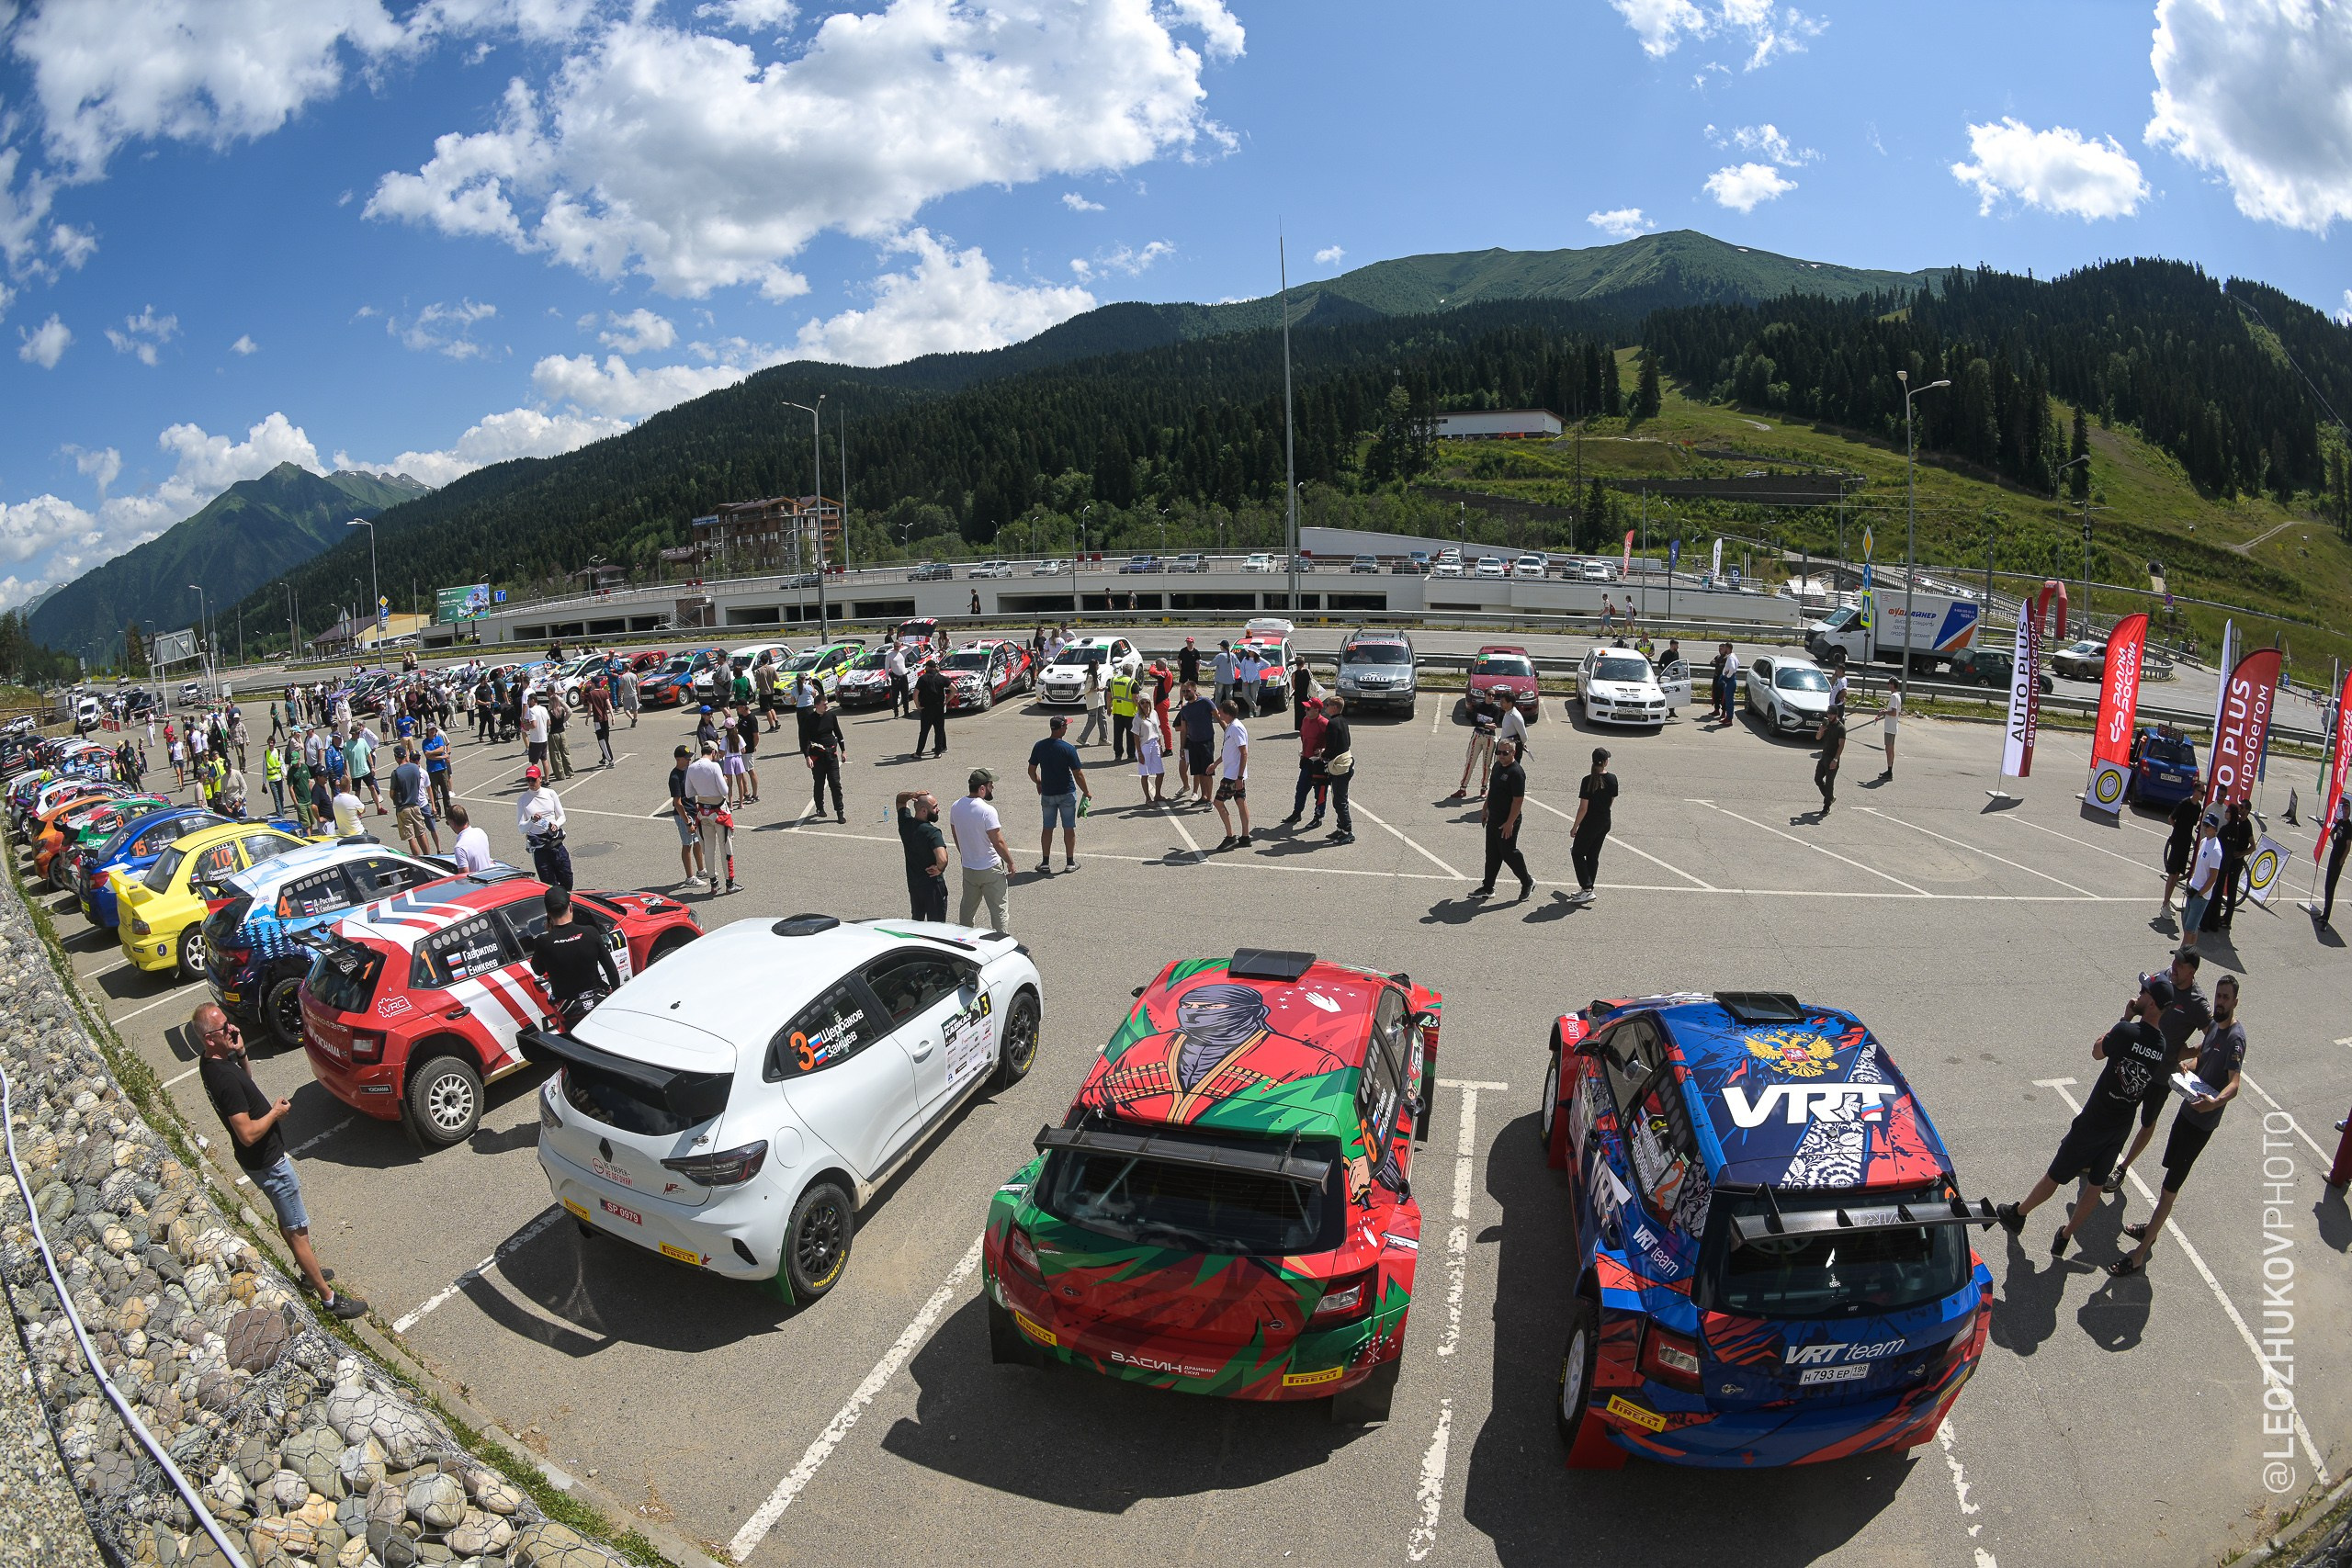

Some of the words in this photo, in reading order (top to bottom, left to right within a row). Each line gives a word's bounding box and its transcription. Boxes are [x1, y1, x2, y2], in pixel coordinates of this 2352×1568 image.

[2018, 621, 2029, 676] PLUS
[2030, 621, 2040, 697] пробегом
[2113, 647, 2127, 705] РАЛЛИ
[2121, 641, 2137, 713] РОССИИ
[2011, 683, 2029, 743] AUTO
[2222, 678, 2251, 757] PLUS
[2026, 714, 2037, 748] авто
[2241, 683, 2269, 782] пробегом
[116, 815, 124, 828] 8
[132, 840, 148, 856] 15
[212, 849, 232, 868] 10
[278, 897, 292, 918] 4
[553, 933, 582, 943] ADVAN
[613, 932, 622, 949] 1
[421, 950, 437, 979] 1
[462, 942, 498, 961] Гаврилов
[363, 961, 374, 980] 1
[467, 959, 499, 976] Еникеев
[383, 998, 406, 1013] VRC
[980, 996, 989, 1015] 3
[819, 1009, 865, 1043] Щербаков
[944, 1012, 972, 1037] КАВКАЗ
[790, 1032, 815, 1071] 3
[824, 1030, 858, 1058] Зайцев
[2131, 1042, 2164, 1062] RUSSIA
[1721, 1082, 1897, 1128] VRT
[1361, 1118, 1377, 1163] 6
[1640, 1116, 1661, 1169] Васильев
[1655, 1160, 1685, 1210] 2
[607, 1202, 618, 1213] SP
[619, 1206, 639, 1223] 0979
[662, 1245, 695, 1263] PIRELLI
[1633, 1224, 1659, 1251] VRT
[1650, 1247, 1679, 1277] team
[813, 1249, 846, 1287] SCORPION
[1018, 1316, 1052, 1342] PIRELLI
[1111, 1350, 1182, 1372] ВАСИН
[1785, 1343, 1849, 1364] VRT
[1844, 1338, 1905, 1361] team
[1287, 1370, 1339, 1385] PIRELLI
[1853, 1365, 1867, 1373] 198
[1612, 1398, 1661, 1427] PIRELLI
